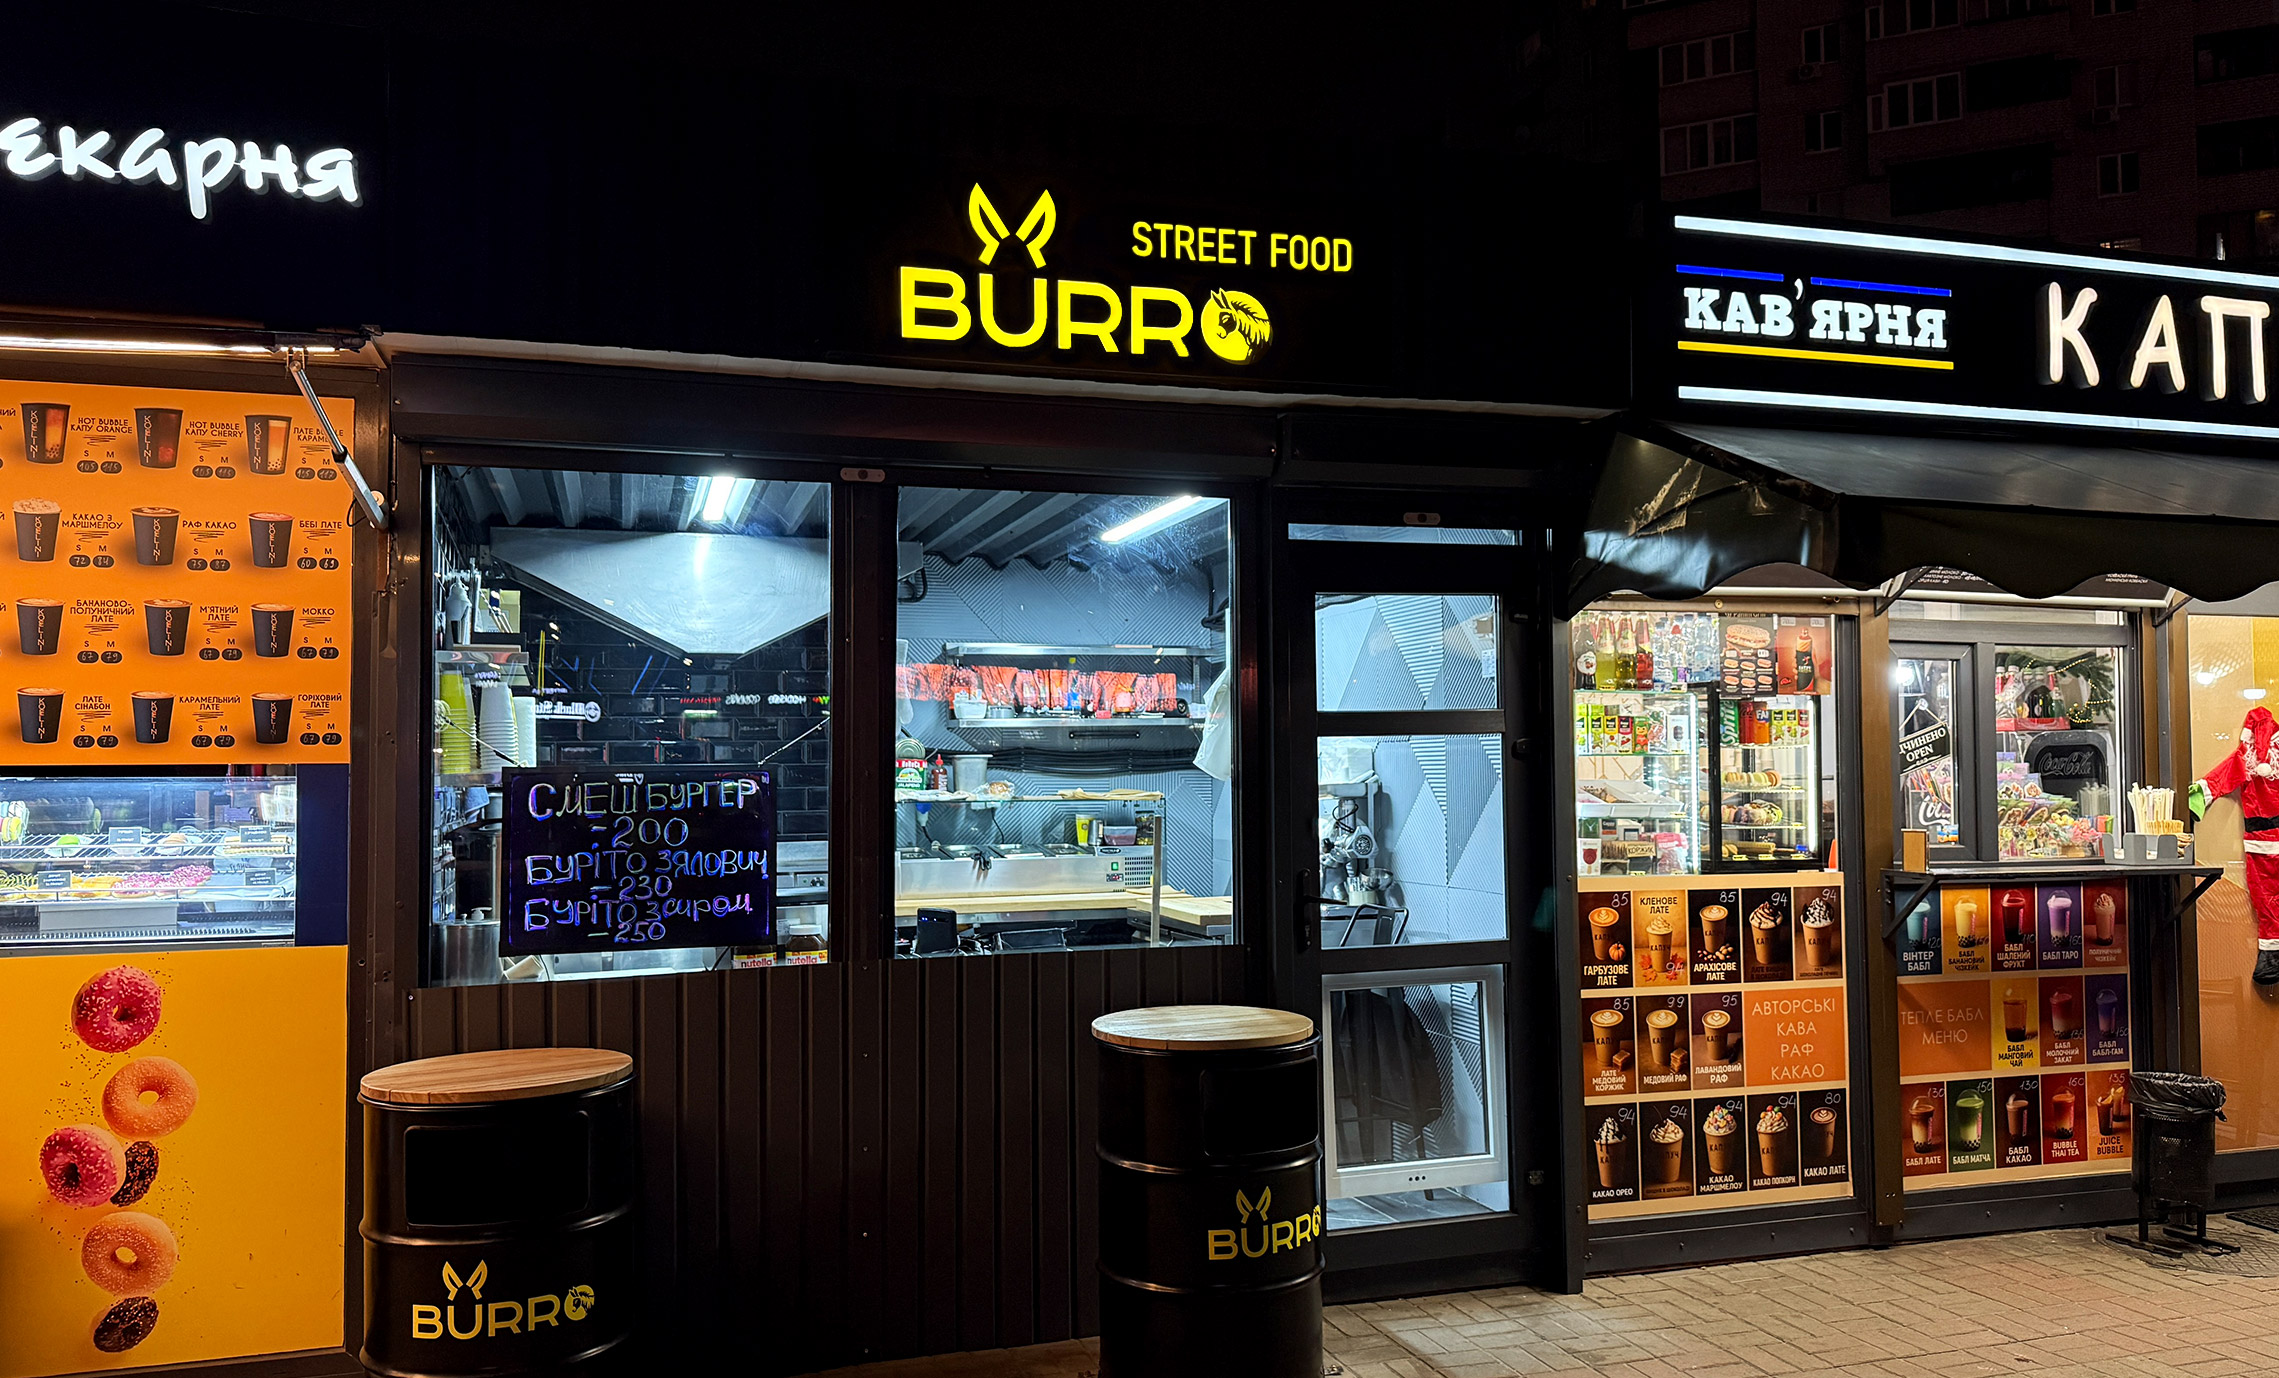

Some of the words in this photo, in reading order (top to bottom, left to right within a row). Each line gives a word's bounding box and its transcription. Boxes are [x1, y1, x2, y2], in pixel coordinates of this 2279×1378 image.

[1132, 222, 1257, 265] STREET
[1270, 233, 1353, 273] FOOD
[900, 265, 1273, 366] BURRO
[1683, 277, 1948, 349] КАВ'ЯРНЯ
[2047, 281, 2271, 402] КАП
[78, 418, 95, 426] HOT
[99, 418, 129, 427] BUBBLE
[210, 422, 240, 431] BUBBLE
[71, 425, 93, 433] КАПУ
[96, 426, 133, 434] ORANGE
[186, 429, 208, 437] КАПУ
[211, 430, 244, 438] CHERRY
[73, 513, 104, 521] КАКАО
[62, 520, 123, 530] МАРШМЕЛОУ
[183, 521, 202, 529] РАФ
[206, 521, 237, 530] КАКАО
[300, 521, 318, 529] БЕБІ
[321, 521, 342, 529] ЛАТЕ
[303, 608, 335, 616] МОККО
[91, 615, 114, 623] ЛАТЕ
[208, 614, 230, 622] ЛАТЕ
[179, 695, 241, 704] КАРАМЕЛЬНИЙ
[298, 693, 342, 702] ГОРІХОВИЙ
[75, 703, 111, 711] СІНАБОН
[200, 703, 220, 711] ЛАТЕ
[311, 701, 330, 709] ЛАТЕ
[1906, 744, 1934, 762] OPEN
[528, 781, 638, 821] СМЕШ
[646, 779, 758, 812] БУРГЕР
[525, 842, 647, 885] БУРІТО
[1612, 893, 1629, 908] 85
[1720, 891, 1737, 903] 85
[1772, 892, 1788, 907] 94
[1822, 889, 1837, 902] 94
[1640, 897, 1678, 906] КЛЕНОВЕ
[525, 895, 638, 931] БУРІТО
[1650, 906, 1670, 914] ЛАТЕ
[2005, 944, 2024, 952] БАБЛ
[1903, 952, 1935, 961] ВІНТЕР
[1997, 950, 2031, 960] ШАЛЕНИЙ
[2043, 951, 2061, 961] БАБЛ
[2062, 951, 2079, 960] ТАРО
[741, 959, 773, 968] nutella
[1949, 957, 1985, 965] БАНАНОВИЙ
[2003, 960, 2025, 968] ФРУКТ
[1584, 965, 1629, 976] ГАРБУЗОВЕ
[1694, 962, 1737, 972] АРАХІСОВЕ
[1908, 962, 1931, 971] БАБЛ
[1597, 976, 1618, 986] ЛАТЕ
[1706, 972, 1726, 981] ЛАТЕ
[1613, 998, 1631, 1011] 85
[1668, 996, 1685, 1008] 99
[1722, 995, 1738, 1007] 95
[1752, 998, 1835, 1016] АВТОРСЬКІ
[1901, 1010, 1943, 1025] ТЕПЛЕ
[1947, 1008, 1984, 1022] БАБЛ
[1777, 1021, 1817, 1036] КАВА
[1922, 1029, 1968, 1045] МЕНЮ
[1781, 1043, 1814, 1058] РАФ
[2046, 1048, 2079, 1057] МОЛОЧНИЙ
[2093, 1048, 2124, 1057] БАБЛ-ГАМ
[1999, 1051, 2034, 1061] МАНГОВИЙ
[2054, 1056, 2072, 1064] ЗАКАТ
[1695, 1063, 1742, 1074] ЛАВАНДОВИЙ
[2010, 1060, 2023, 1068] ЧАЙ
[1771, 1063, 1825, 1081] КАКАО
[1593, 1075, 1626, 1085] МЕДОВИЙ
[1644, 1074, 1674, 1085] МЕДОВИЙ
[1675, 1074, 1688, 1083] РАФ
[1710, 1074, 1729, 1084] РАФ
[1596, 1084, 1624, 1092] КОРЖИК
[1778, 1095, 1797, 1109] 94
[1825, 1092, 1841, 1105] 80
[1726, 1100, 1743, 1112] 94
[1618, 1108, 1636, 1125] 94
[1669, 1106, 1688, 1119] 94
[2053, 1141, 2077, 1150] BUBBLE
[2099, 1137, 2121, 1146] JUICE
[2009, 1146, 2029, 1155] БАБЛ
[2052, 1150, 2067, 1158] THAI
[2068, 1149, 2080, 1157] TEA
[2097, 1145, 2124, 1155] BUBBLE
[1906, 1158, 1923, 1166] БАБЛ
[1925, 1156, 1942, 1165] ЛАТЕ
[1953, 1157, 1970, 1165] БАБЛ
[1971, 1154, 1991, 1162] МАТЧА
[2006, 1154, 2032, 1164] КАКАО
[1804, 1167, 1828, 1177] КАКАО
[1829, 1165, 1846, 1175] ЛАТЕ
[1709, 1175, 1734, 1184] КАКАО
[1753, 1179, 1771, 1187] КАКАО
[1700, 1182, 1743, 1192] МАРШМЕЛОУ
[1593, 1190, 1615, 1198] КАКАО
[1616, 1188, 1634, 1197] ОРЕО
[413, 1285, 595, 1340] BURRO
